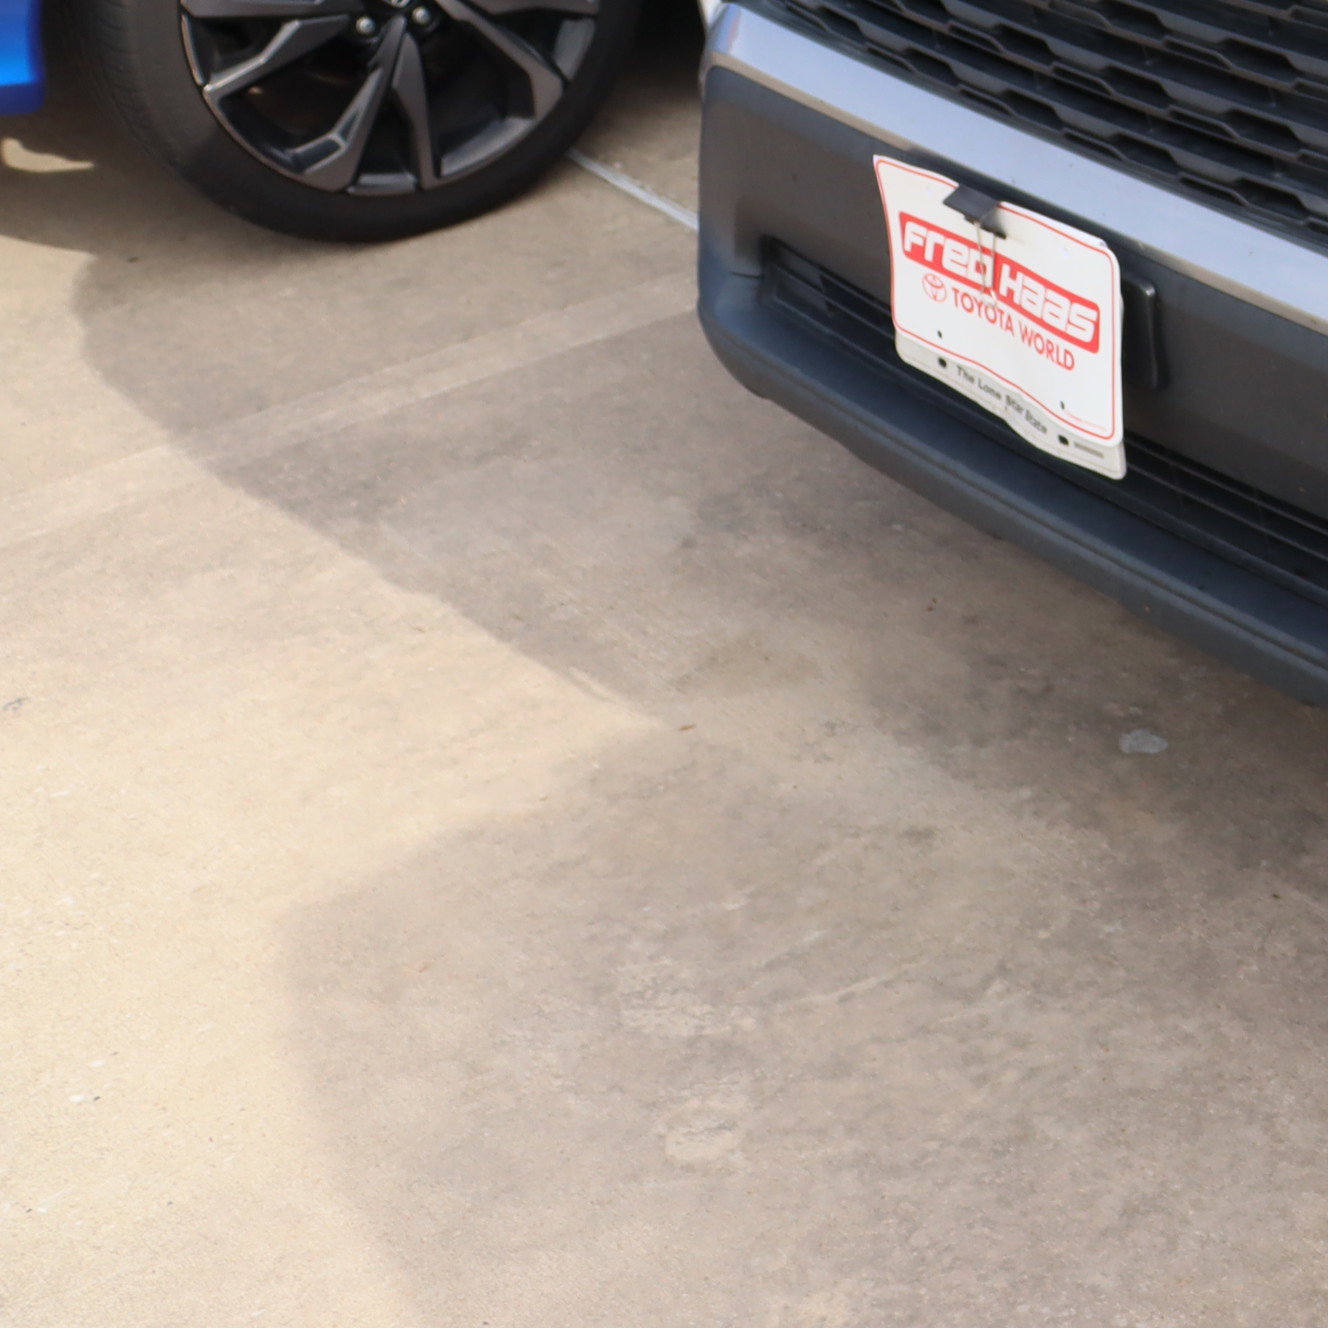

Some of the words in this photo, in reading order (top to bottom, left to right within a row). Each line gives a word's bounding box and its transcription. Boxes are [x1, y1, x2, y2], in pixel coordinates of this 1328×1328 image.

[952, 287, 1015, 337] TOYOTA
[1018, 320, 1075, 371] WORLD
[999, 263, 1098, 343] Haas
[956, 365, 975, 383] The
[977, 378, 1002, 401] Lone
[1005, 394, 1025, 413] Star
[1025, 409, 1048, 434] State
